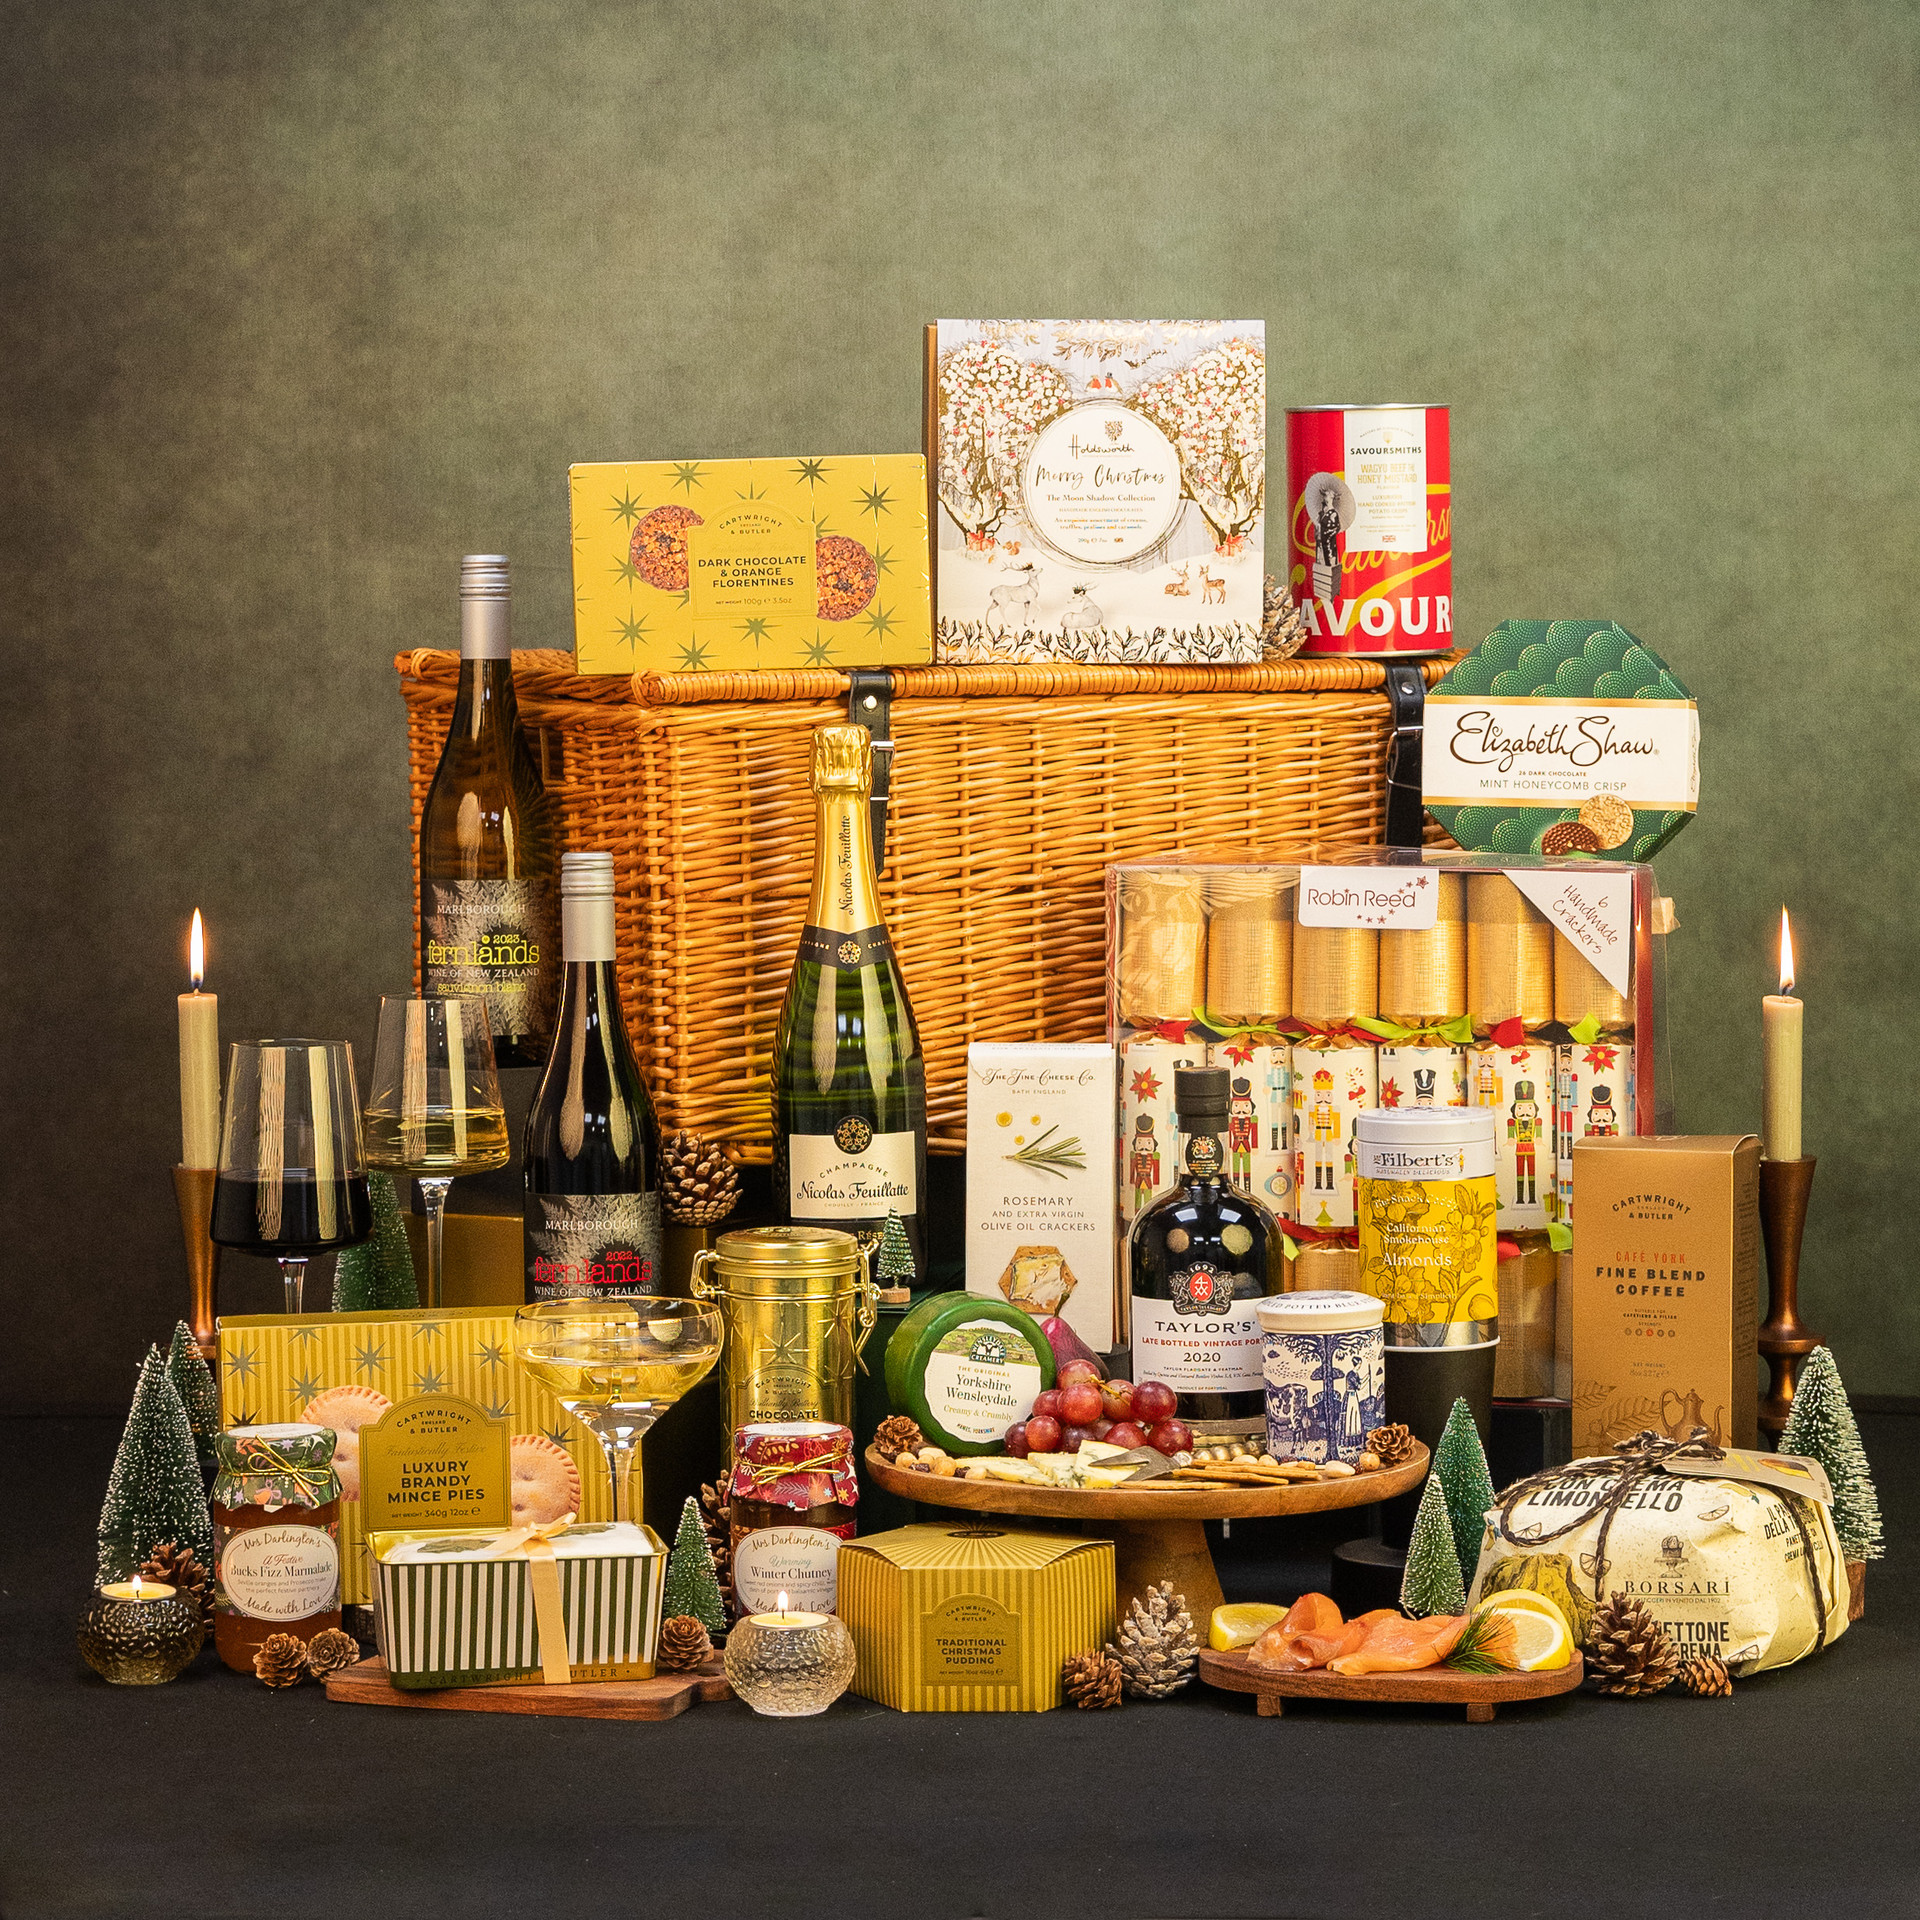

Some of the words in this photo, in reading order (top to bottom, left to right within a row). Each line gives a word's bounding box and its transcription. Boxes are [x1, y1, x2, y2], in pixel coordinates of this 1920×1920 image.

[1068, 434, 1134, 460] Holdsworth
[1350, 447, 1422, 455] SAVOURSMITHS
[1360, 464, 1388, 473] WAGYU
[1036, 465, 1084, 490] Merry
[1094, 464, 1166, 488] Christmas
[1357, 474, 1381, 484] HONEY
[1384, 474, 1417, 483] MUSTARD
[1046, 494, 1061, 502] The
[1087, 494, 1115, 502] Shadow
[1117, 494, 1155, 502] Collection
[719, 515, 782, 529] CARTWRIGHT
[698, 559, 731, 567] DARK
[735, 556, 806, 566] CHOCOLATE
[720, 569, 727, 577] &
[732, 568, 781, 577] ORANGE
[713, 577, 794, 588] FLORENTINES
[744, 598, 762, 606] 100g
[1449, 710, 1572, 773] Elizabeth
[1570, 715, 1655, 767] Shaw
[1480, 779, 1509, 789] MINT
[1513, 780, 1590, 791] HONEYCOMB
[1594, 781, 1627, 792] CRISP
[838, 815, 852, 870] Feuillatte
[839, 870, 854, 916] Nicolas
[1307, 887, 1360, 907] Robin
[1363, 890, 1417, 909] Reed
[1598, 896, 1608, 908] 6
[436, 904, 526, 915] MARLBOROUGH
[1564, 885, 1617, 945] Handmade
[1552, 900, 1601, 954] Crackers
[493, 935, 520, 944] 2023
[427, 939, 540, 965] fernlands
[428, 968, 448, 977] WINE
[450, 969, 463, 977] OF
[466, 969, 492, 977] NEW
[494, 968, 540, 977] ZEALAND
[496, 981, 527, 992] blanc
[1381, 1153, 1454, 1167] Filbert's
[820, 1162, 888, 1178] CHAMPAGNE
[796, 1181, 845, 1199] Nicolas
[848, 1181, 909, 1200] Feuillatte
[1003, 1196, 1074, 1206] ROSEMARY
[1612, 1194, 1691, 1214] CARTWRIGHT
[1638, 1212, 1673, 1220] BUTLER
[545, 1219, 638, 1231] MARLBOROUGH
[981, 1222, 1013, 1231] OLIVE
[1016, 1222, 1034, 1231] OIL
[1039, 1222, 1096, 1231] CRACKERS
[1386, 1222, 1446, 1233] Californian
[1384, 1234, 1449, 1244] Smokehouse
[1382, 1252, 1452, 1266] Almonds
[1654, 1253, 1686, 1263] YORK
[534, 1256, 652, 1284] fernlands
[1190, 1263, 1214, 1274] 1692
[1596, 1267, 1636, 1279] FINE
[1647, 1269, 1705, 1281] BLEND
[534, 1286, 558, 1296] WINE
[560, 1287, 572, 1296] OF
[578, 1287, 603, 1297] NEW
[607, 1285, 652, 1297] ZEALAND
[1616, 1284, 1685, 1297] COFFEE
[1155, 1321, 1252, 1334] TAYLOR'S
[1142, 1337, 1158, 1345] LATE
[1161, 1338, 1200, 1347] BOTTLED
[970, 1355, 1005, 1364] CREAMERY
[1183, 1352, 1221, 1362] 2020
[974, 1368, 1010, 1377] ORIGINAL
[956, 1374, 1012, 1392] Yorkshire
[946, 1386, 1017, 1407] Wensleydale
[397, 1410, 471, 1428] CARTWRIGHT
[749, 1410, 819, 1419] CHOCOLATE
[944, 1405, 972, 1416] Creamy
[982, 1411, 1013, 1423] Crumbly
[403, 1461, 469, 1474] LUXURY
[401, 1475, 471, 1489] BRANDY
[1600, 1478, 1685, 1492] CEMA
[387, 1491, 441, 1504] MINCE
[448, 1489, 485, 1501] PIES
[1527, 1491, 1683, 1512] LIMONELLO
[424, 1509, 447, 1518] 340g
[450, 1508, 469, 1516] 12oz
[1764, 1518, 1790, 1540] DELLA
[244, 1539, 262, 1552] Mrs
[264, 1530, 321, 1548] Darlington's
[752, 1539, 769, 1552] Mrs
[771, 1531, 830, 1550] Darlington's
[231, 1565, 258, 1577] Bucks
[260, 1566, 282, 1577] Fizz
[284, 1561, 332, 1577] Marmalade
[751, 1566, 786, 1579] Winter
[788, 1568, 832, 1579] Chutney
[256, 1587, 277, 1595] perfect
[1625, 1581, 1730, 1594] BORSARI
[245, 1597, 273, 1613] Made
[275, 1603, 300, 1614] with
[302, 1596, 322, 1611] Love
[946, 1605, 996, 1617] CARTWRIGHT
[429, 1673, 534, 1685] CARTWRIGHT
[570, 1669, 618, 1679] UTLER
